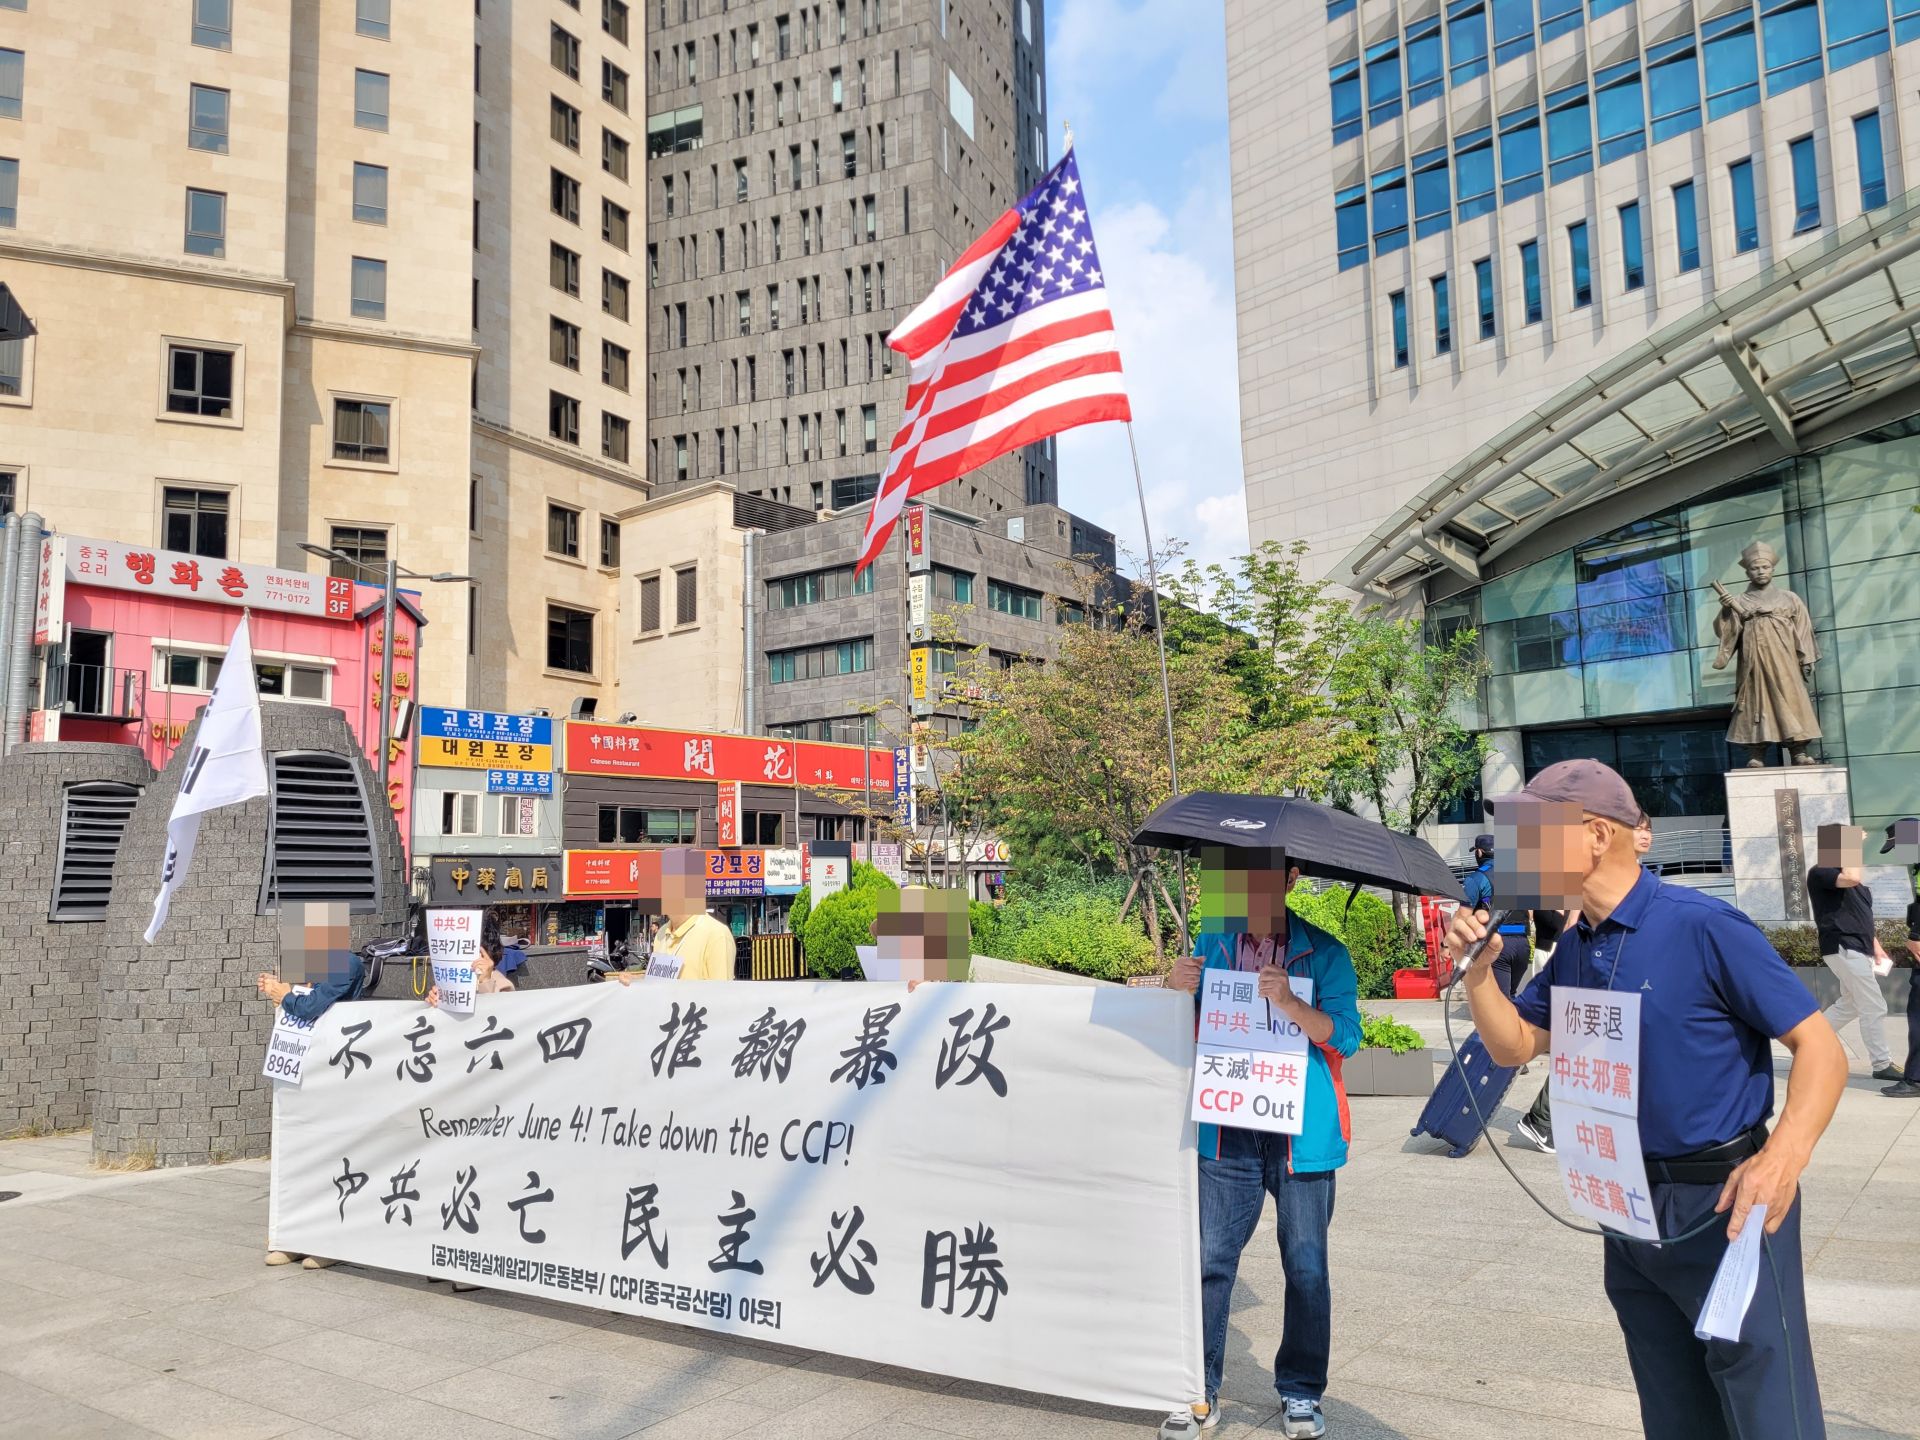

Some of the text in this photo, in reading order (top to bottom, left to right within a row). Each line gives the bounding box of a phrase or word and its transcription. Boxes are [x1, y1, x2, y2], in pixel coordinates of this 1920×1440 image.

[79, 545, 108, 561] 중국
[39, 541, 52, 611] 杏花村
[78, 561, 107, 576] 요리
[125, 552, 249, 598] 행화촌
[266, 574, 310, 591] 연회석완비
[329, 580, 349, 596] 2F
[265, 590, 311, 605] 771-0172
[329, 600, 349, 614] 3F
[441, 710, 535, 735] 고려포장
[441, 739, 535, 762] 대원포장
[590, 733, 640, 752] 中國料理
[590, 758, 612, 766] Chinese
[490, 771, 551, 787] 유명포장
[721, 799, 734, 841] 開花
[451, 867, 548, 891] 中華書局
[433, 916, 470, 931] 中共의
[430, 938, 476, 955] 공작기관
[434, 966, 473, 983] 공자학원
[647, 957, 679, 979] Remember
[1210, 979, 1253, 1004] 中國
[1206, 1009, 1250, 1034] 中共
[1272, 1020, 1301, 1038] NO
[1565, 1000, 1624, 1041] 你要退
[272, 1033, 307, 1057] Remember
[329, 1002, 1011, 1097] 不忘六四 推翻暴政
[267, 1054, 301, 1079] 8964
[1202, 1054, 1298, 1086] 天滅中共
[1554, 1052, 1633, 1100] 中共邪黨
[1199, 1088, 1295, 1121] CCP Out
[419, 1103, 855, 1167] Remember June 4! Take down the CCP!
[1575, 1119, 1618, 1163] 中國
[332, 1156, 1009, 1323] 中共必亡 民主必勝
